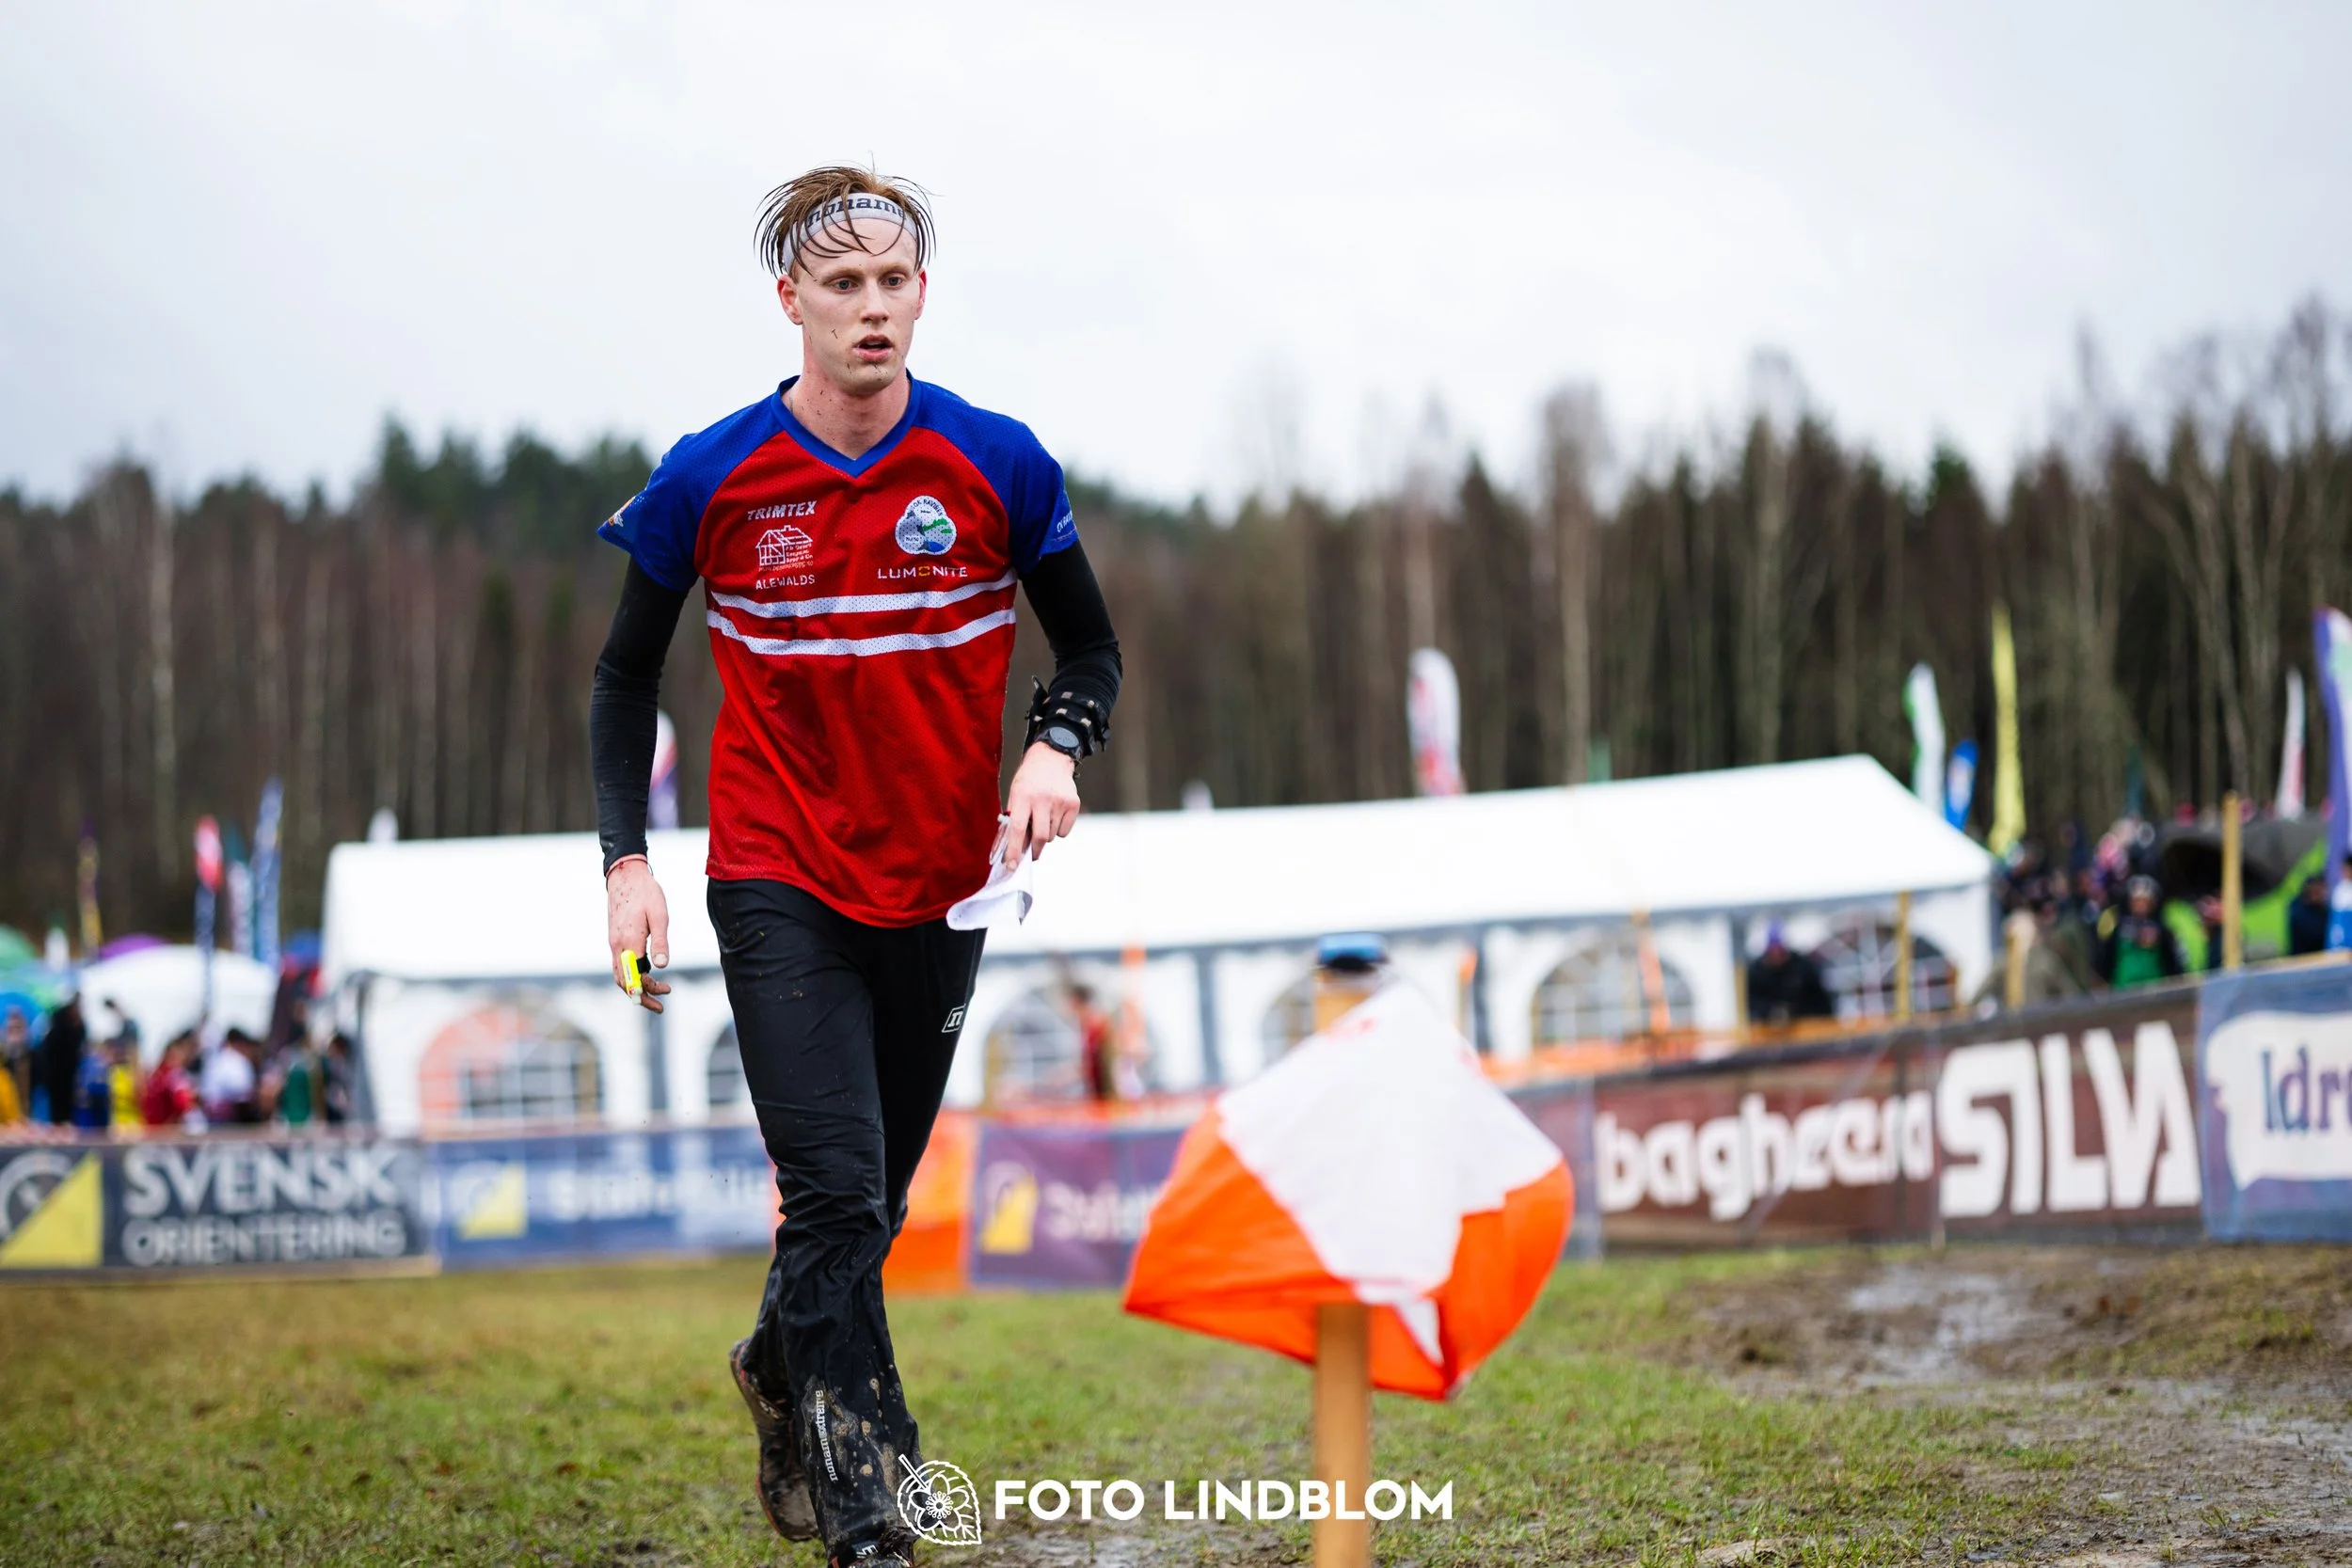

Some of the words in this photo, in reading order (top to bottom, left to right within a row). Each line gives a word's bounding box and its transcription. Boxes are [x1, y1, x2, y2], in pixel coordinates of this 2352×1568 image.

[747, 500, 817, 520] TRIMTEX
[755, 574, 816, 590] ALEWALDS
[877, 565, 968, 579] LUMONITE
[1936, 1020, 2202, 1217] SILVA
[2260, 1046, 2352, 1132] Idr
[122, 1142, 400, 1216] SVENSK
[1594, 1090, 1934, 1221] bagheera
[121, 1210, 406, 1267] ORIENTERING
